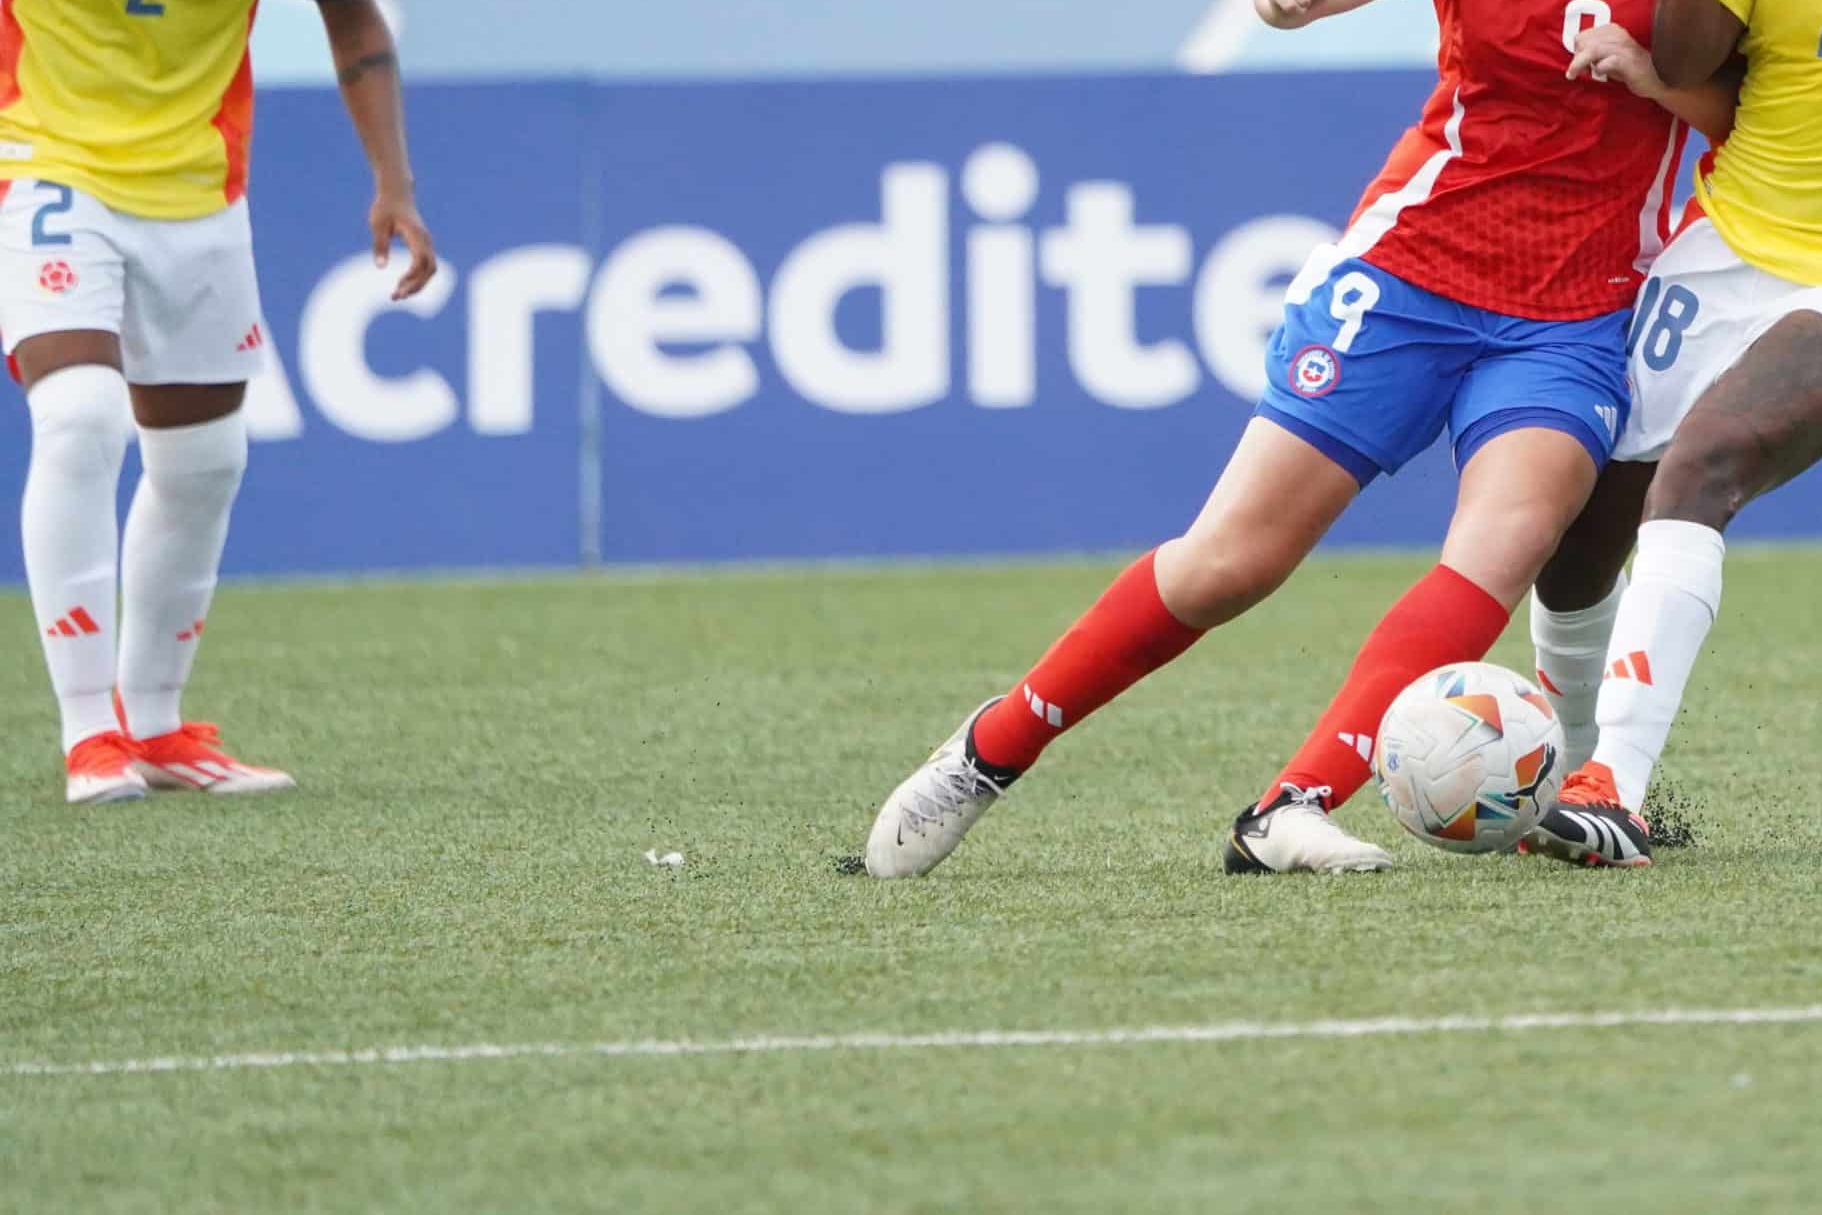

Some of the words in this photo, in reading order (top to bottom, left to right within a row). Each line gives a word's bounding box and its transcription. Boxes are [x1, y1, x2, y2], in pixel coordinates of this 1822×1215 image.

[32, 178, 73, 246] 2
[1331, 271, 1380, 353] 9
[1626, 276, 1699, 371] 18
